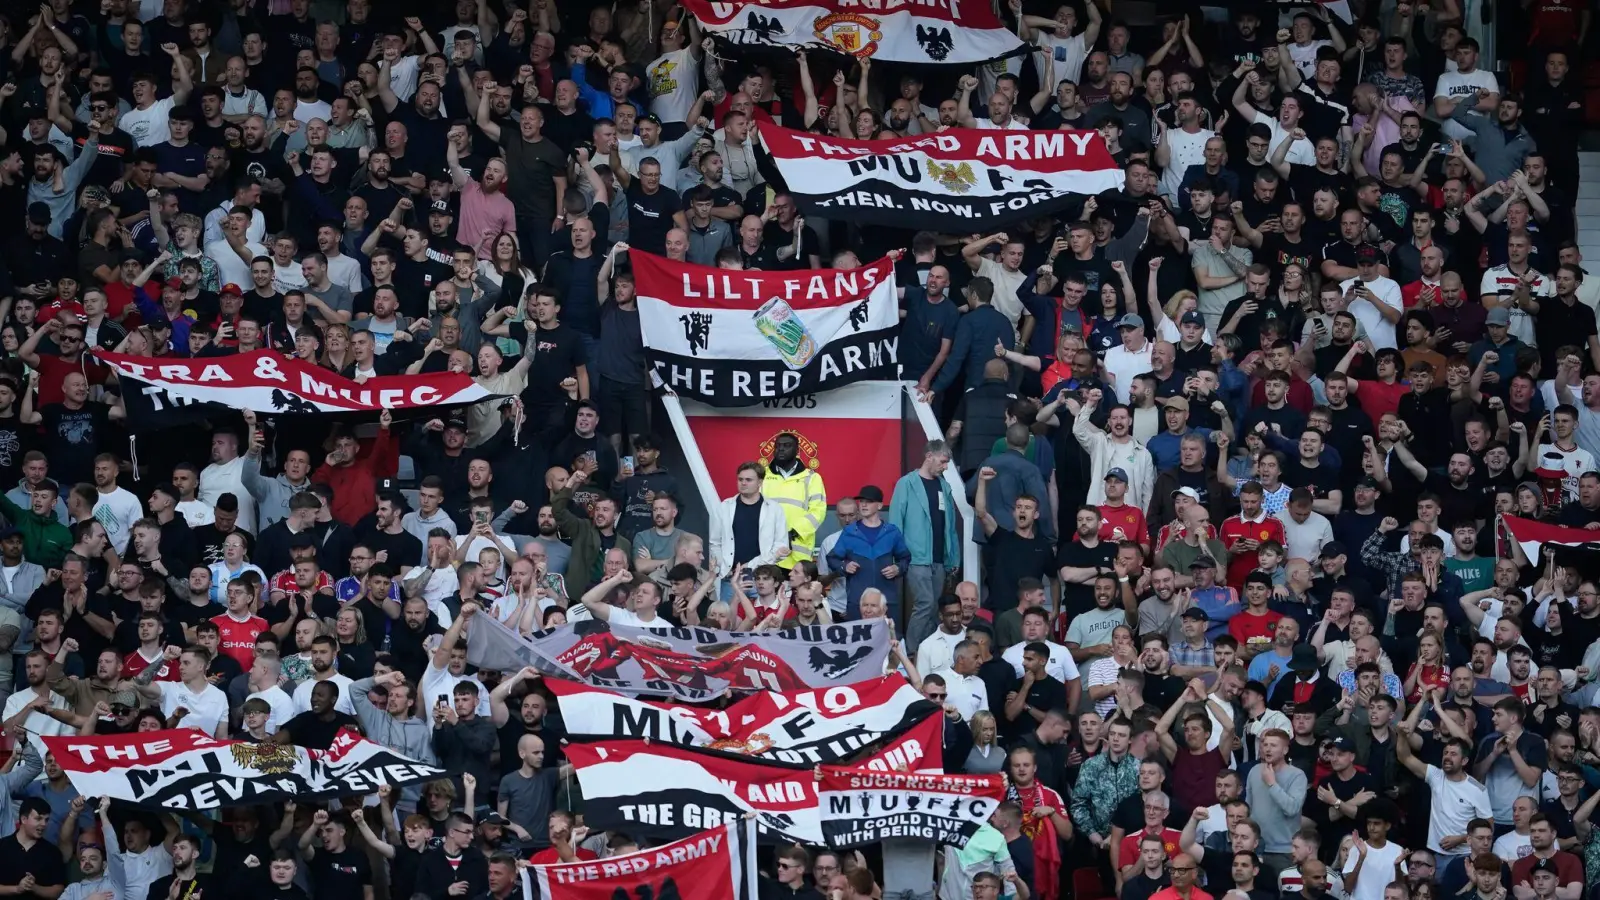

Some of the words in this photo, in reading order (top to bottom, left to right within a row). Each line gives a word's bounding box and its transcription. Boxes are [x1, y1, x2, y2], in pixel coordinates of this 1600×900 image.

[98, 145, 114, 153] OSS
[976, 132, 1095, 161] ARMY
[815, 190, 904, 210] THEN.
[910, 197, 982, 219] NOW.
[682, 272, 765, 300] LILT
[784, 267, 880, 300] FANS
[252, 355, 288, 383] &
[732, 369, 803, 398] RED
[818, 335, 900, 382] ARMY
[762, 393, 818, 409] W205
[1454, 568, 1481, 580] NIKE
[744, 667, 783, 693] 11
[67, 738, 173, 766] THE
[340, 763, 448, 791] EVER
[850, 776, 900, 789] SUCH
[942, 776, 990, 788] SEEN
[748, 780, 806, 803] AND
[617, 803, 675, 826] THE
[682, 803, 743, 830] GRE
[829, 796, 851, 813] M
[880, 795, 899, 811] U
[927, 797, 944, 809] F
[968, 799, 987, 818] C
[852, 820, 858, 831] I
[864, 813, 922, 831] COULD
[927, 816, 964, 832] LIVE
[833, 829, 874, 847] WITH
[879, 825, 934, 839] BEING
[552, 868, 599, 885] THE
[601, 857, 651, 878] RED
[654, 833, 722, 869] ARMY
